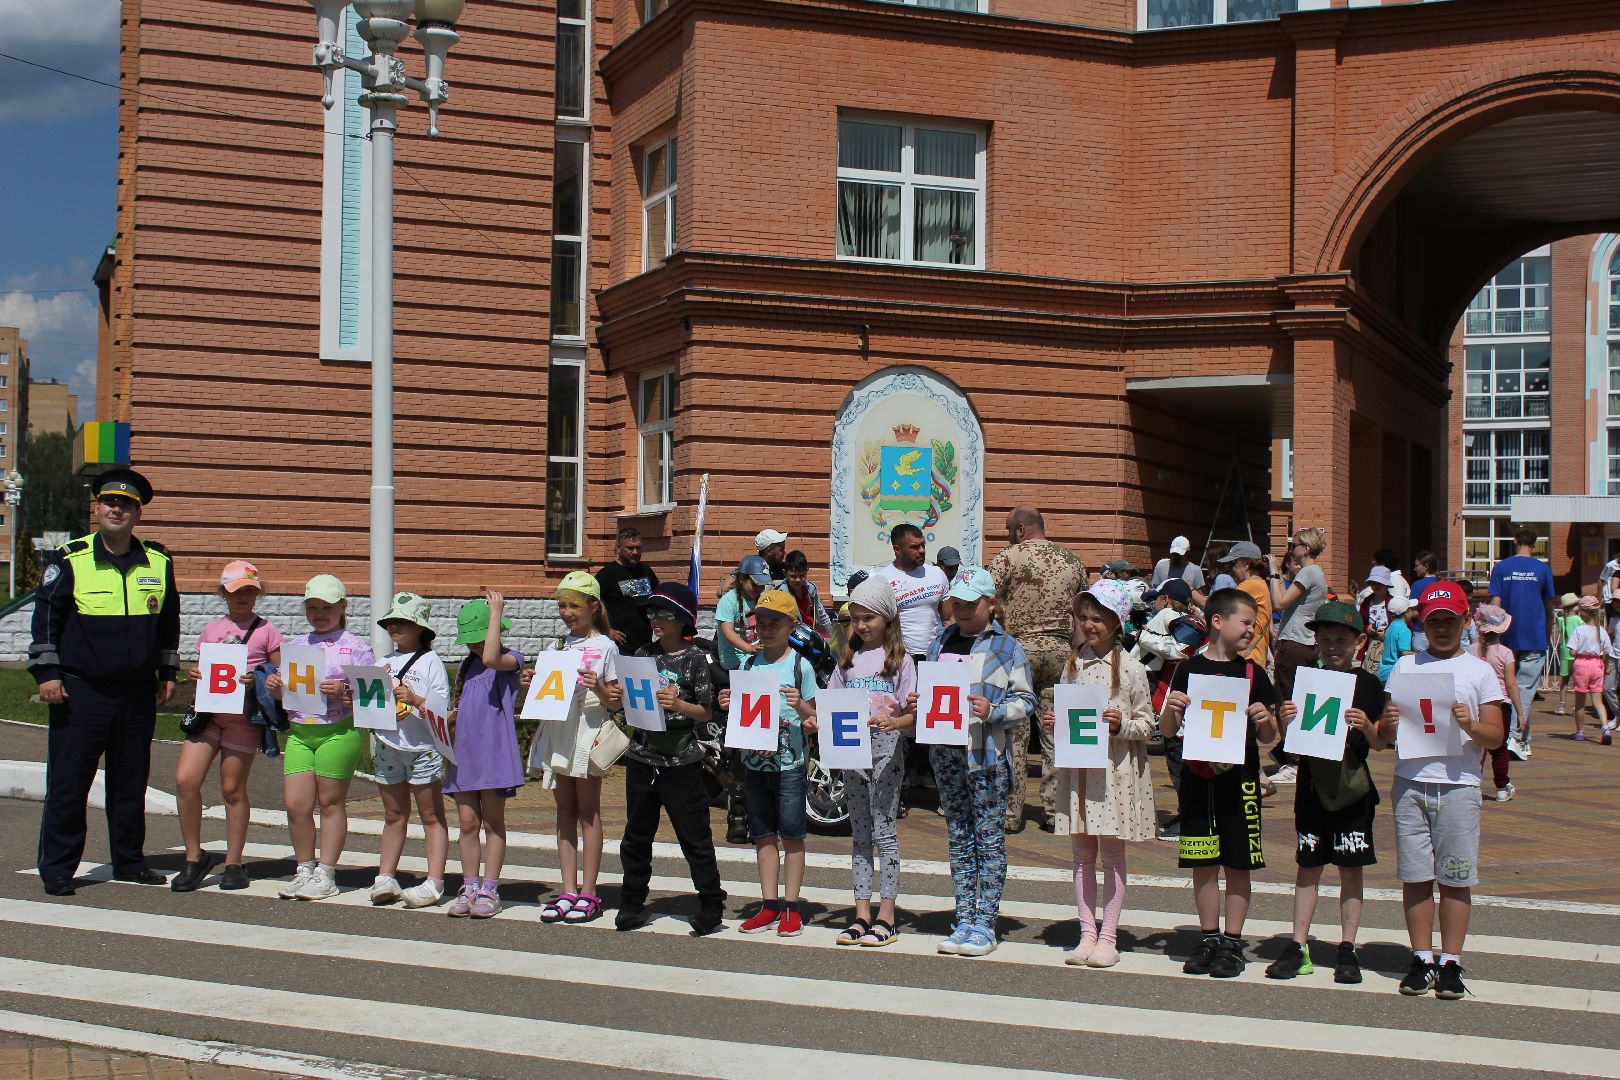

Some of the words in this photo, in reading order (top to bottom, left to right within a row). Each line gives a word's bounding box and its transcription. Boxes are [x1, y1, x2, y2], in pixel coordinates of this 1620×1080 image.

[1427, 590, 1451, 600] FILA
[209, 663, 237, 694] В
[289, 662, 316, 695] Н
[357, 678, 386, 709] И
[535, 670, 565, 701] А
[624, 677, 655, 711] Н
[740, 693, 771, 729] И
[926, 685, 963, 730] Д
[1201, 700, 1237, 739] Т
[1301, 693, 1341, 736] И
[1419, 698, 1436, 734] !
[832, 711, 861, 747] Е
[1068, 708, 1099, 745] Е
[1241, 781, 1264, 864] DIGITIZE
[1180, 848, 1215, 856] ENERGY
